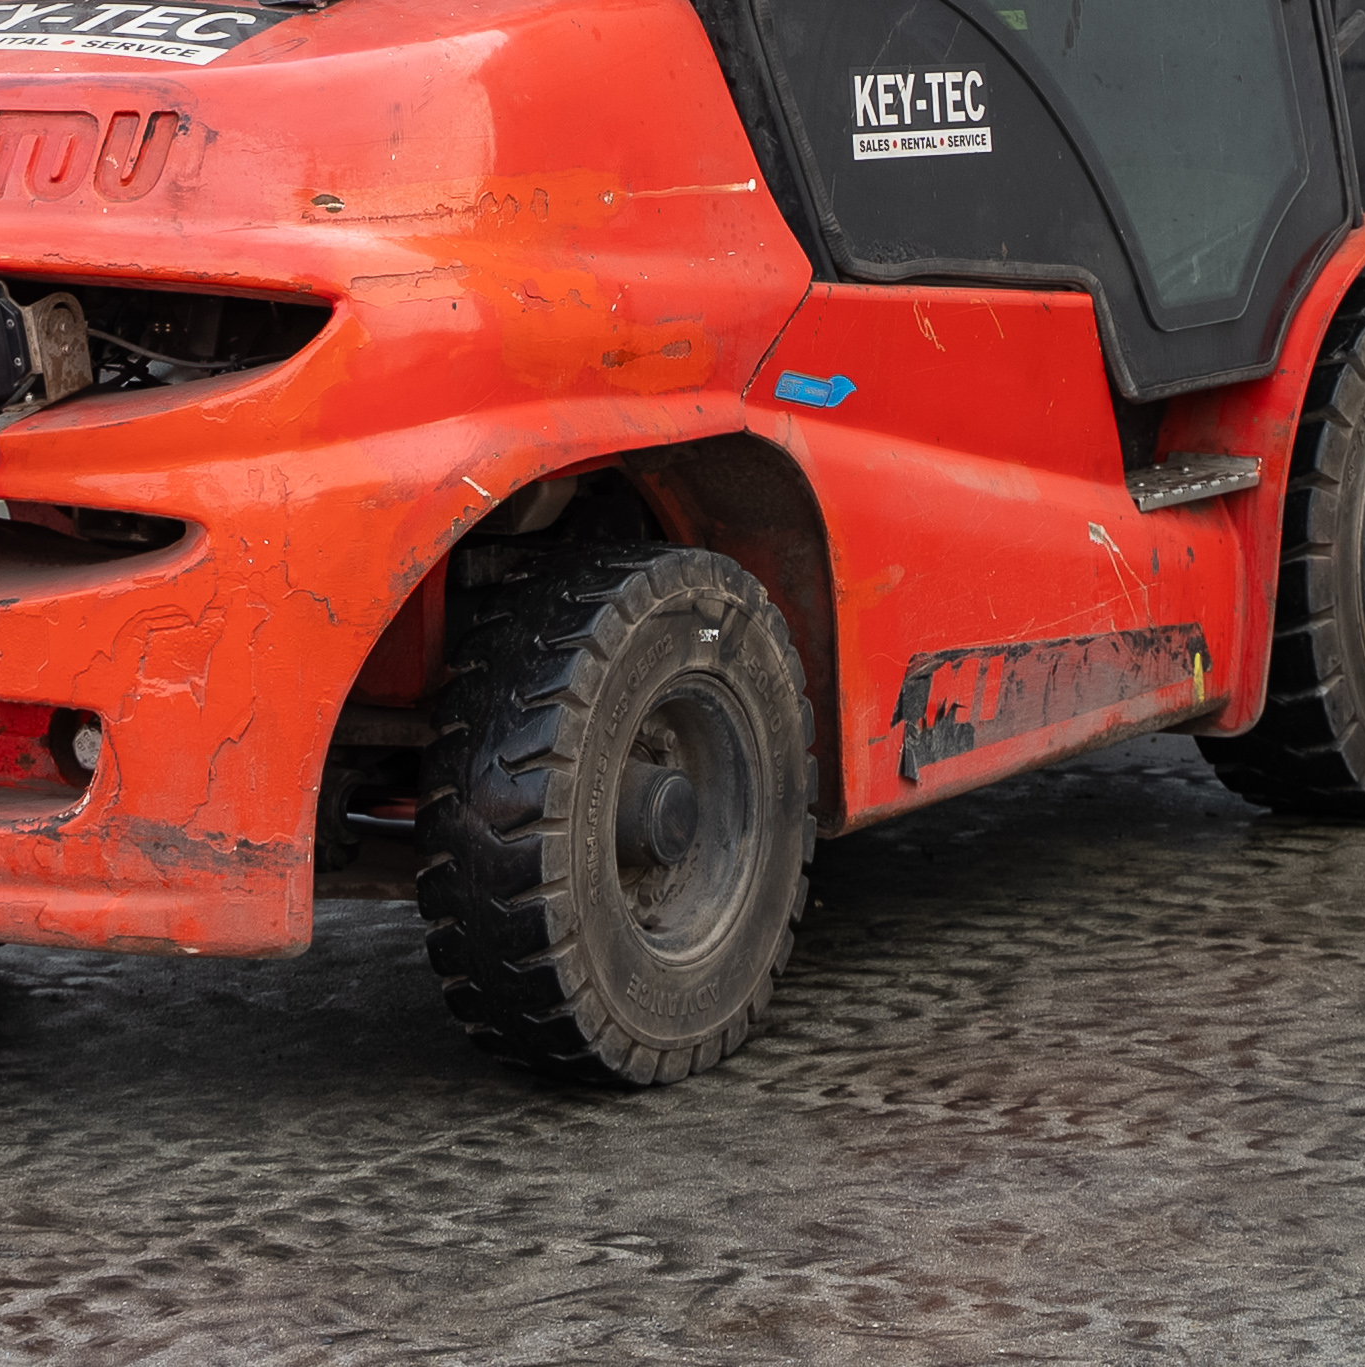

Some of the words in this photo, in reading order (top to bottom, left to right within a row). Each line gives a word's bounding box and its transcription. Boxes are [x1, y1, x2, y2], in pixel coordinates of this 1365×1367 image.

[81, 39, 201, 59] SERVICE
[853, 70, 986, 127] KEY-TEC
[859, 139, 890, 153] SALES
[900, 136, 938, 151] RENTAL
[947, 133, 987, 148] SERVICE
[625, 972, 721, 1017] ADVANCE
